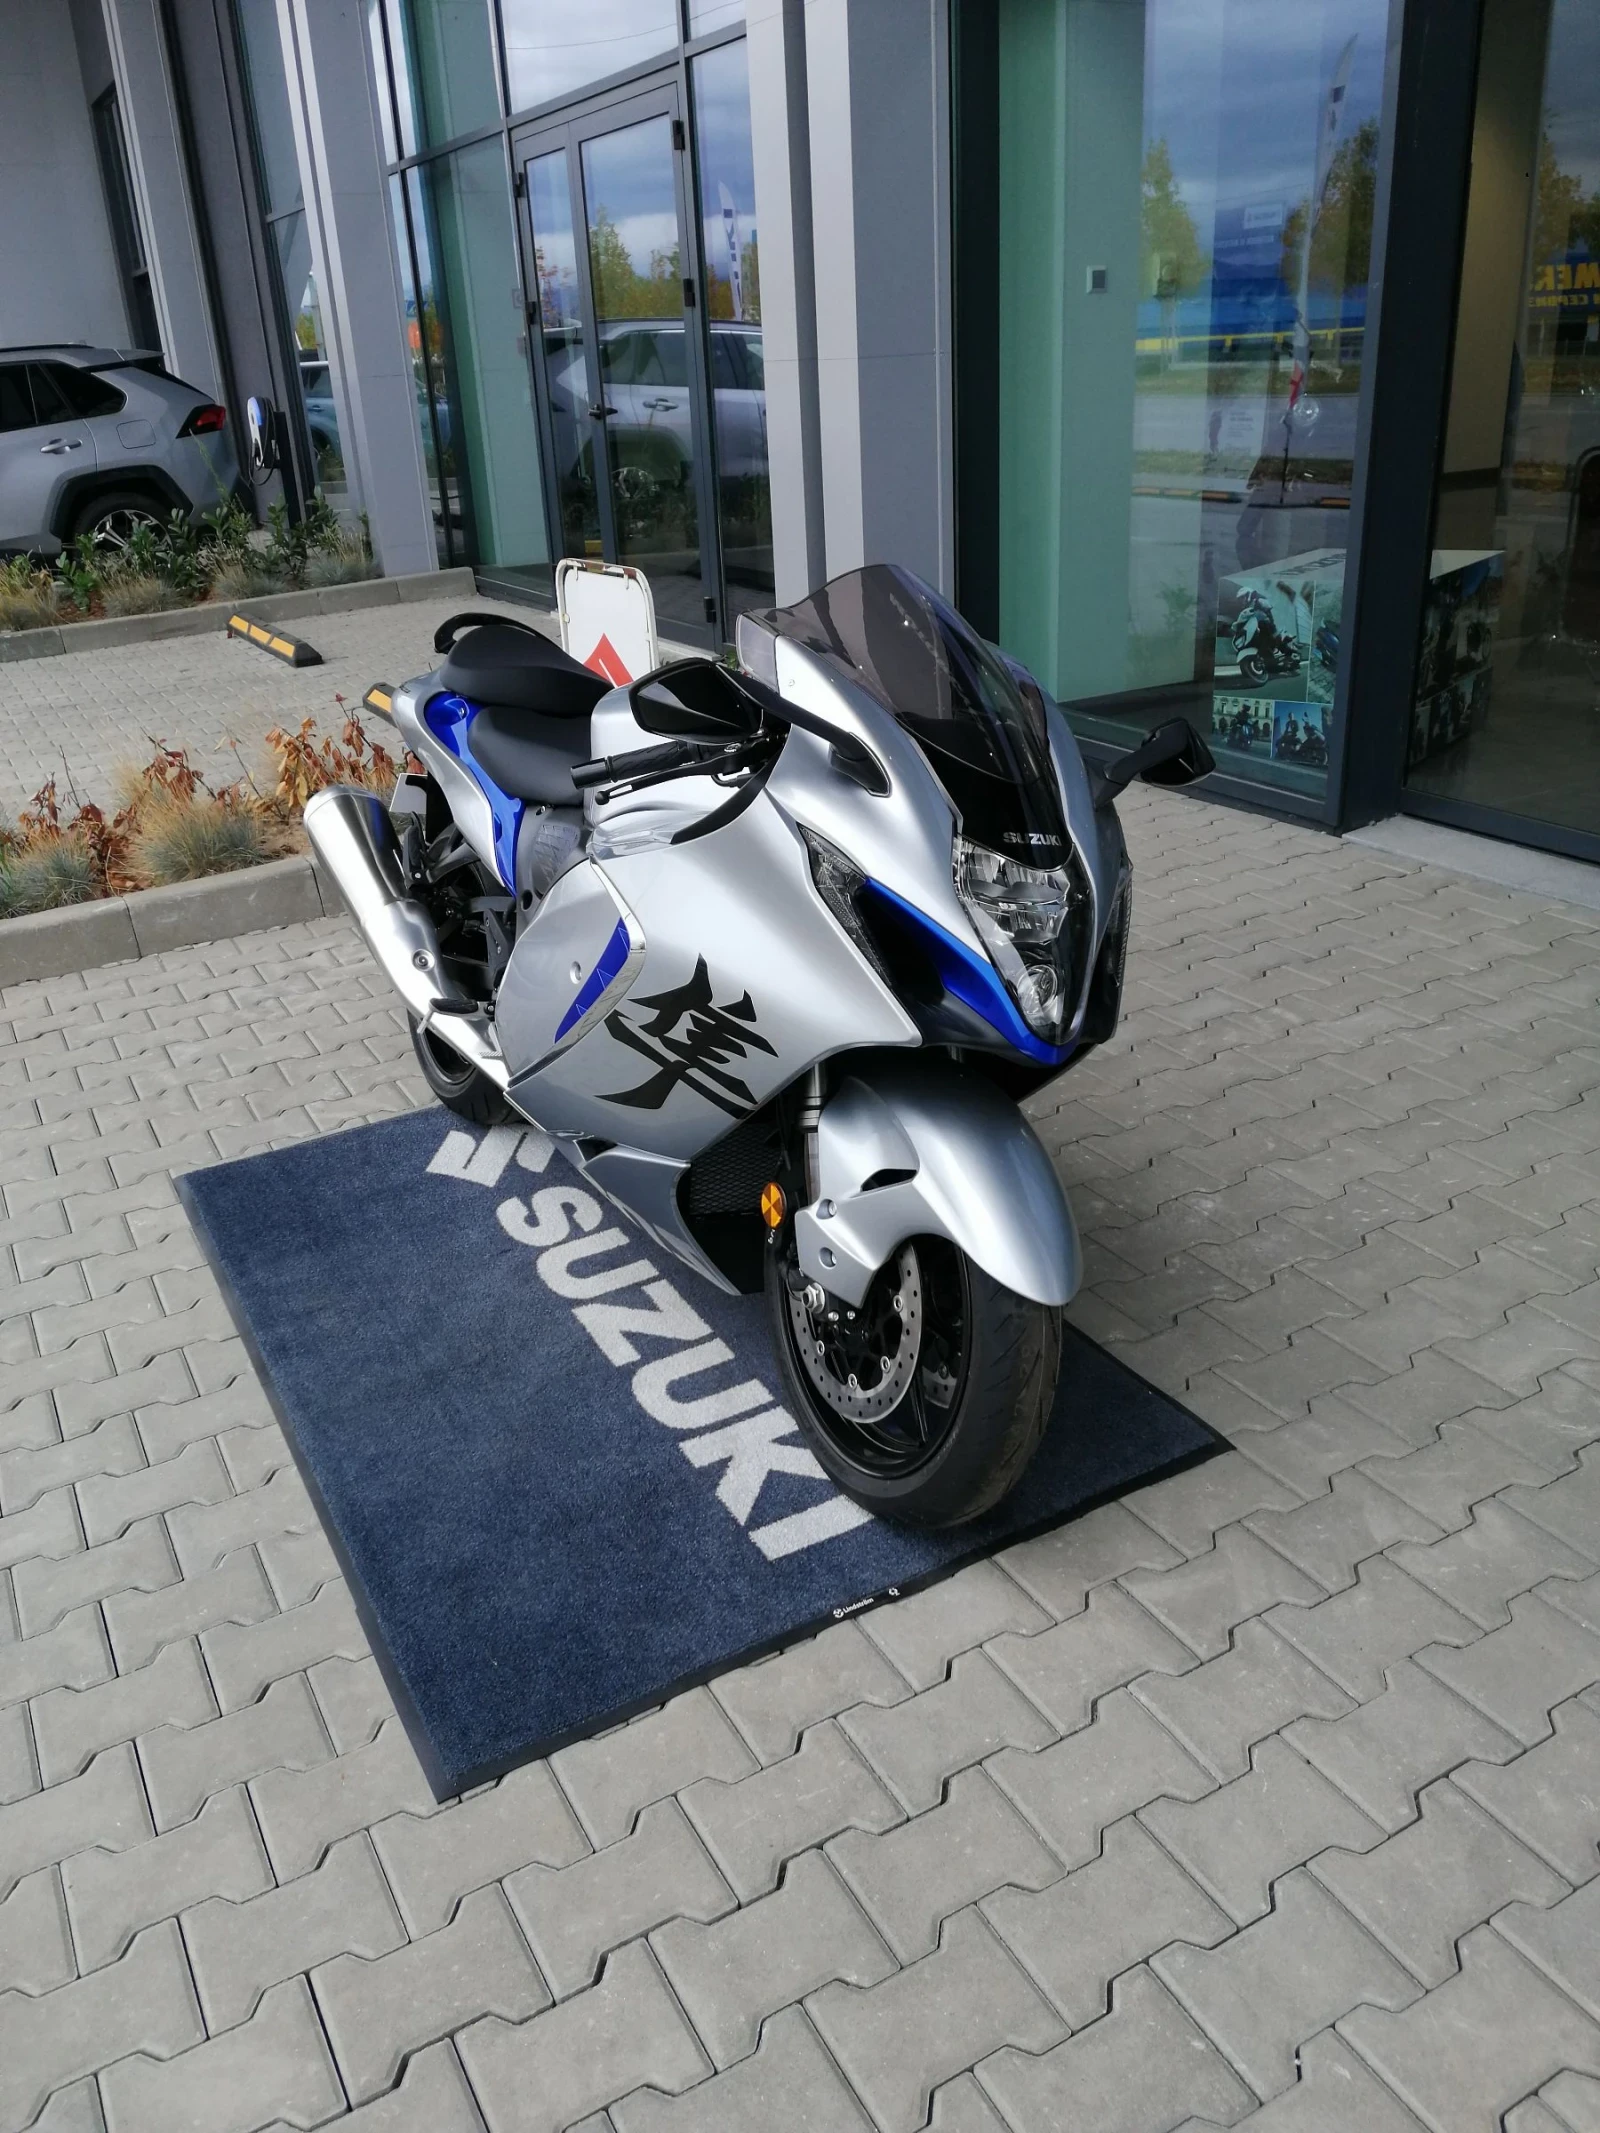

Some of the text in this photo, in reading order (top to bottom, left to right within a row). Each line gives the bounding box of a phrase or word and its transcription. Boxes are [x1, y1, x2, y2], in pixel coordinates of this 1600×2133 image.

[1003, 831, 1062, 846] SUZUKI
[593, 953, 779, 1120] 隼
[496, 1185, 875, 1562] SUZUKI
